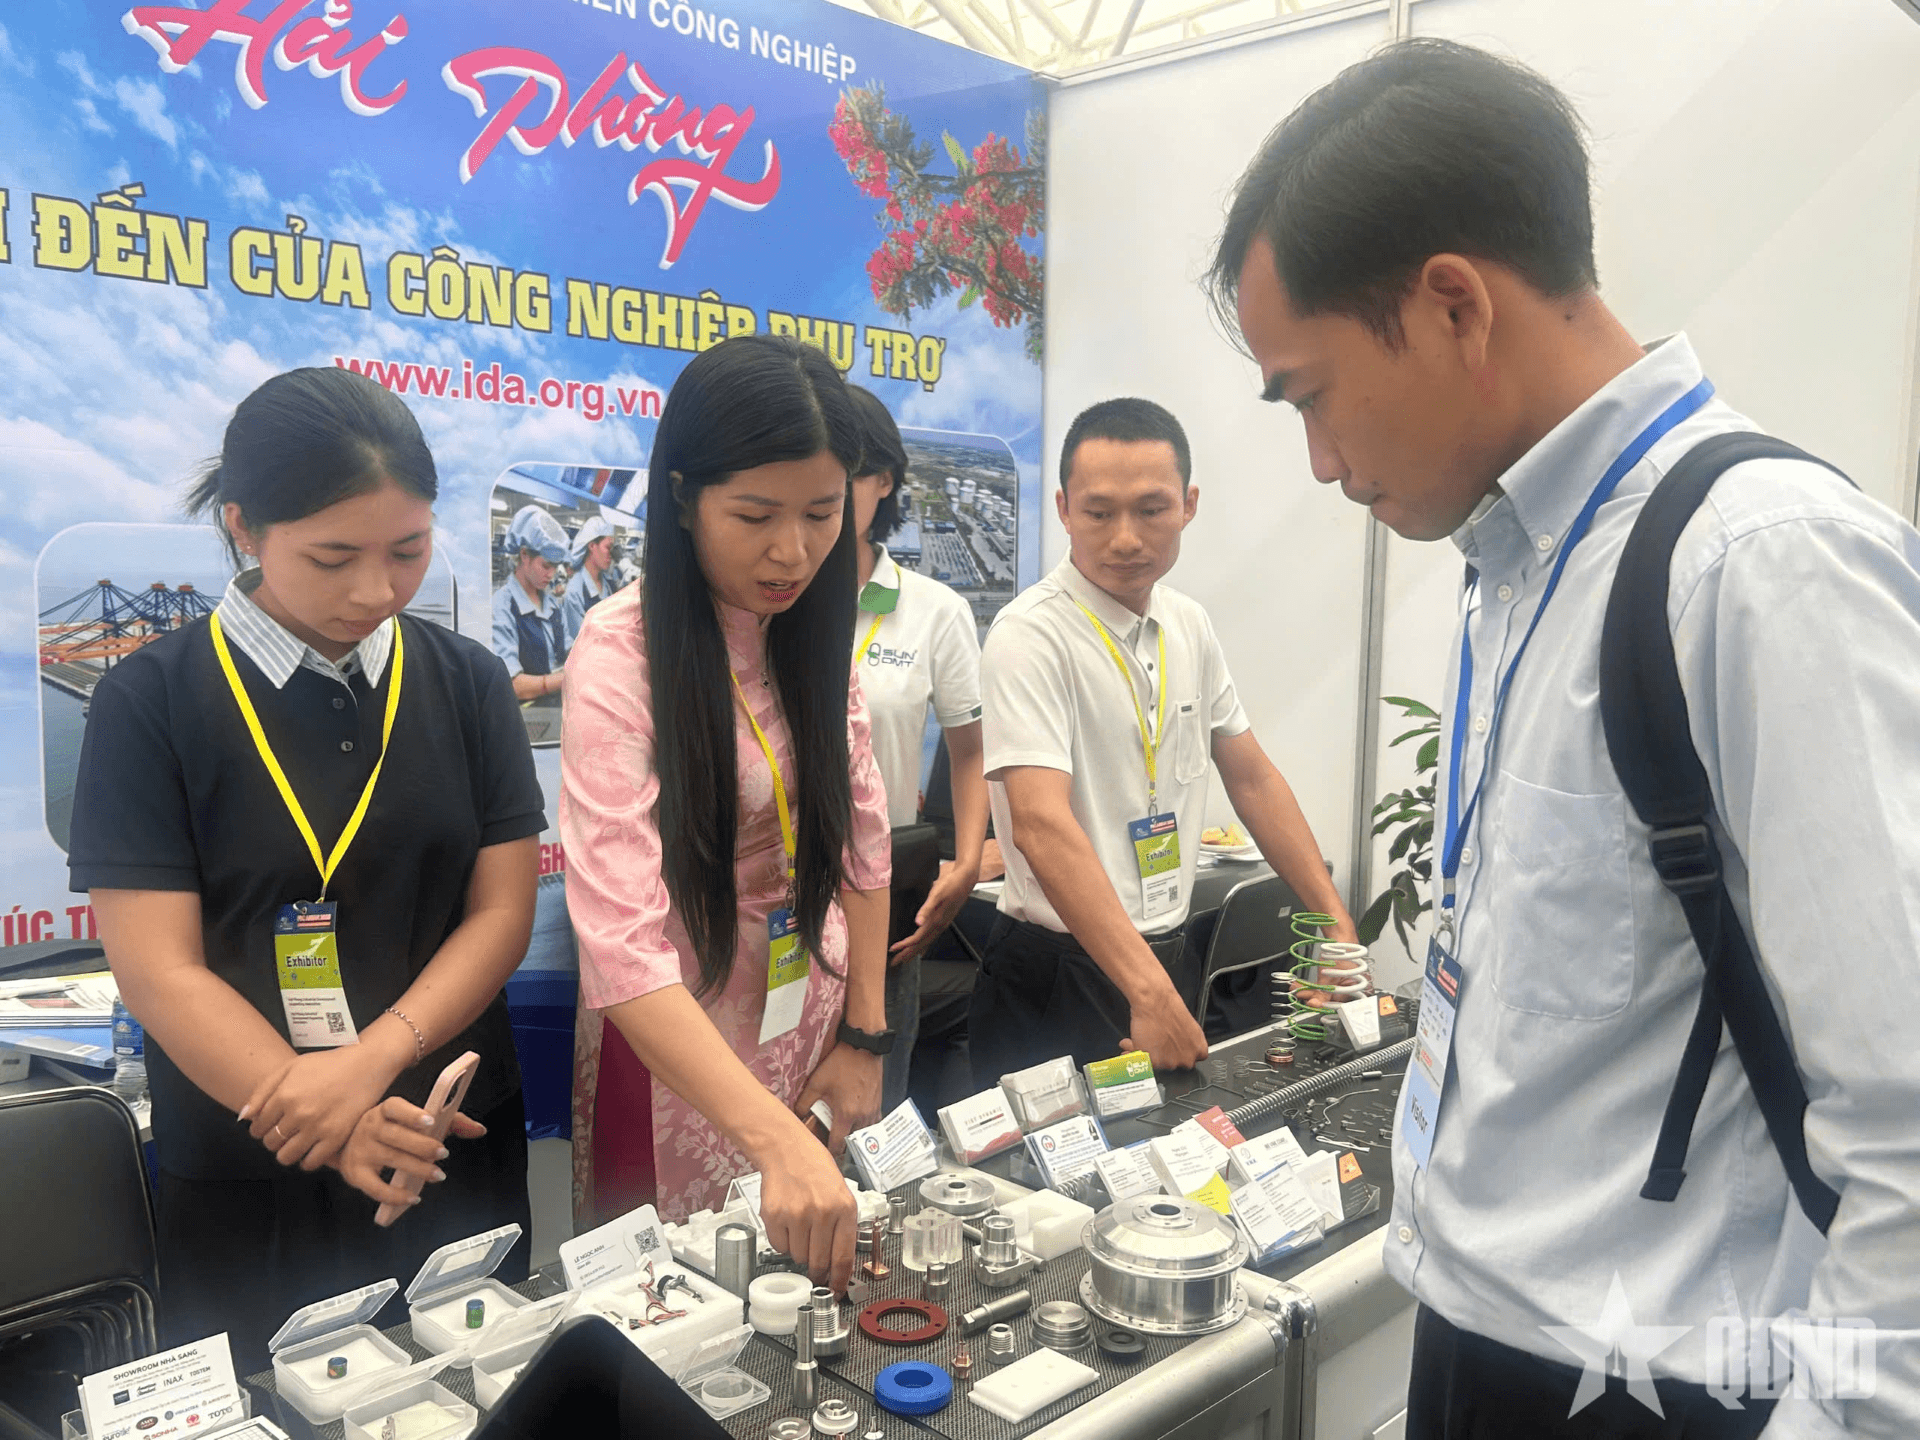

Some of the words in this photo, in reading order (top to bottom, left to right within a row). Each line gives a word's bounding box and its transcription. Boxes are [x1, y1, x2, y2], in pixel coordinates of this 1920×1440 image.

[648, 0, 741, 51] CÔNG
[750, 26, 858, 84] NGHIỆP
[441, 46, 782, 270] Phòng
[31, 181, 209, 290] ĐẾN
[229, 213, 372, 311] CỦA
[387, 245, 552, 334] CÔNG
[863, 325, 947, 393] TRỢ
[882, 649, 915, 660] SUN
[0, 904, 55, 948] ÚC
[285, 955, 327, 968] Exhibitor
[113, 1361, 159, 1382] SHOWROOM
[160, 1355, 177, 1366] NHÀ
[177, 1348, 198, 1361] SANG
[163, 1375, 184, 1387] INAX
[207, 1406, 233, 1420] TOTO
